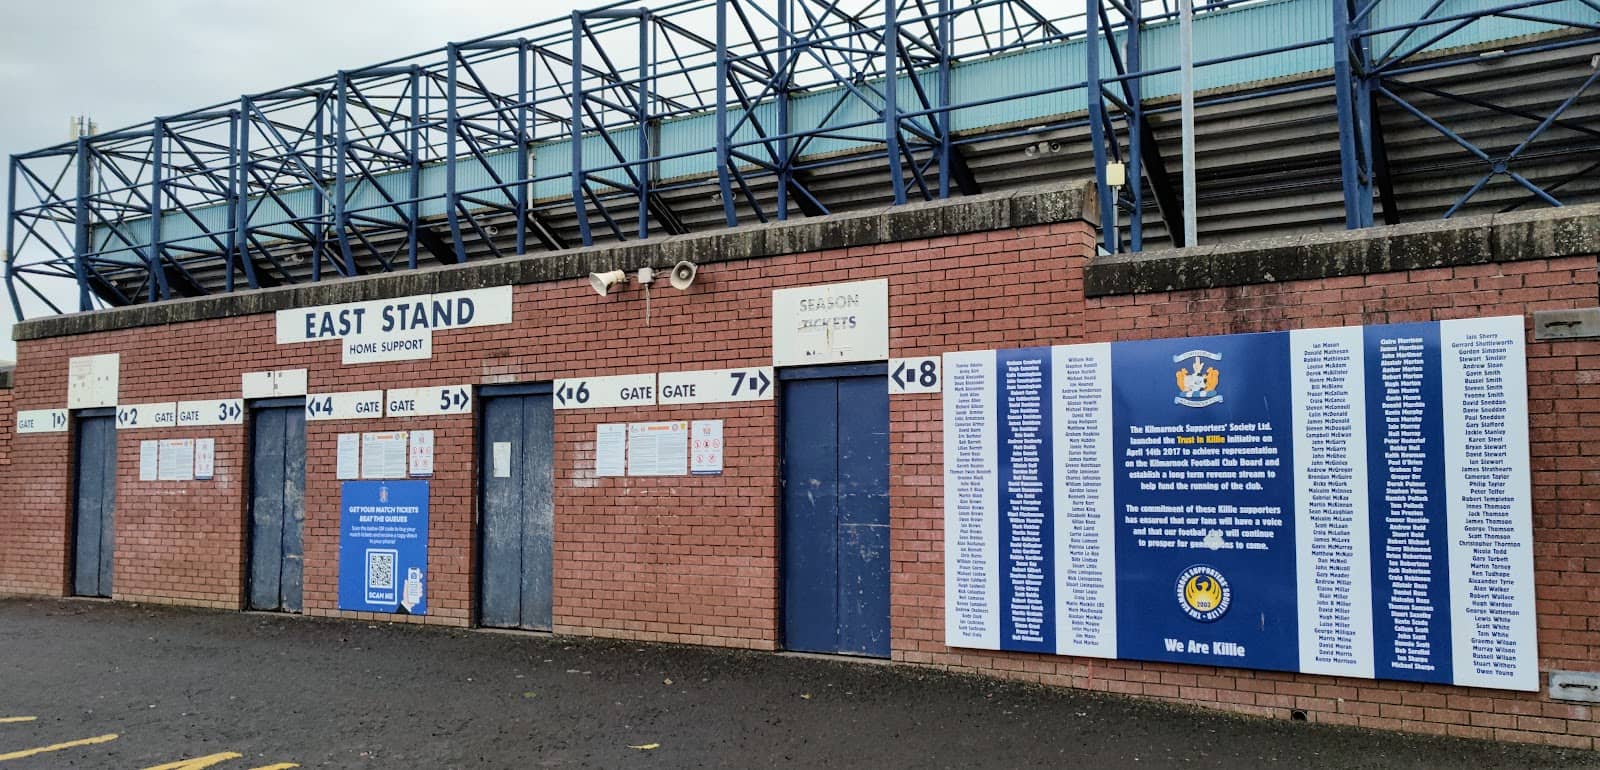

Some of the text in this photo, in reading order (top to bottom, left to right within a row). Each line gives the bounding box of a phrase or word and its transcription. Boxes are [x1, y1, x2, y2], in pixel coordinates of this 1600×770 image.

[799, 294, 859, 312] SEASON
[306, 298, 475, 338] EAST STAND
[350, 339, 423, 354] HOME SUPPORT
[919, 360, 937, 387] 8
[576, 382, 652, 403] 6 GATE
[662, 372, 747, 398] GATE 7
[322, 397, 379, 416] 4 GATE
[390, 389, 450, 411] GATE 5
[130, 408, 174, 425] 2 GATE
[179, 403, 227, 421] GATE 3
[19, 413, 56, 429] GATE 1
[1130, 422, 1272, 433] The Kilmarnock Supporters' Society Ltd.
[1206, 435, 1225, 443] Killie
[1226, 434, 1260, 442] initiative
[1126, 448, 1143, 456] April
[1163, 447, 1181, 455] 2017
[1221, 446, 1277, 454] representation
[1221, 458, 1238, 466] Club
[1129, 470, 1160, 478] establish
[1168, 470, 1185, 478] long
[1140, 482, 1156, 490] help
[1190, 482, 1219, 490] running
[1126, 504, 1138, 512] The
[1195, 505, 1216, 513] these
[1218, 505, 1237, 513] Killie
[1239, 506, 1280, 514] supporters
[1169, 516, 1184, 524] that
[1234, 517, 1253, 525] have
[1262, 517, 1282, 525] voice
[1147, 527, 1162, 535] that
[1225, 529, 1239, 537] will
[1177, 539, 1188, 547] for
[385, 592, 393, 600] ME
[1164, 638, 1245, 656] We Are Killie
